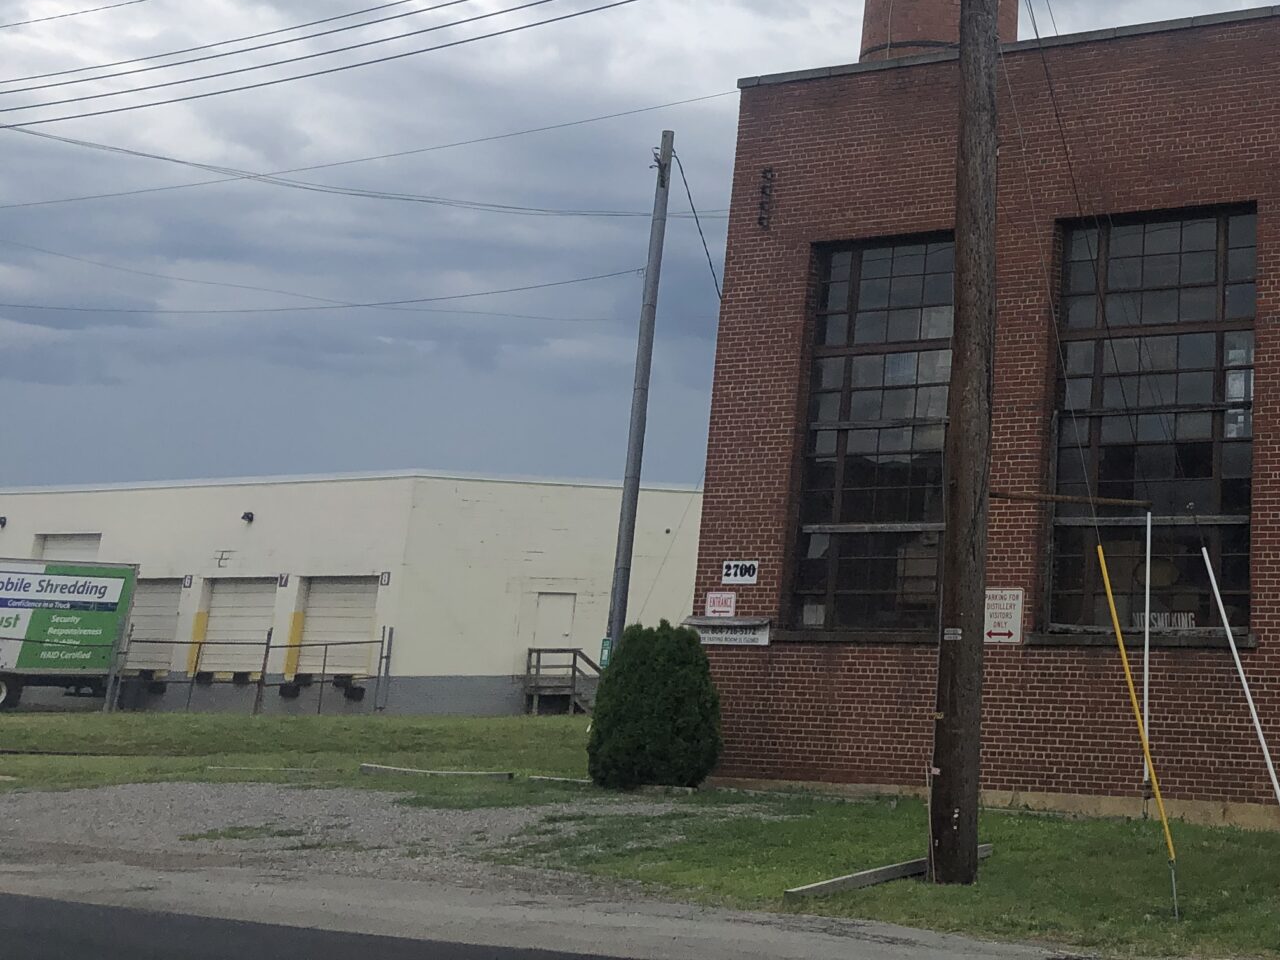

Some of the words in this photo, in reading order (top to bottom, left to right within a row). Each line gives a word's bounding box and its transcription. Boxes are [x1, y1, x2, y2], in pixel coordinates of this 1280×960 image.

[724, 564, 756, 577] 2700
[35, 580, 108, 599] Shredding
[985, 593, 1007, 601] PARKING
[1008, 593, 1019, 601] FOR
[986, 602, 1016, 610] DISTILLERY
[989, 611, 1012, 619] VISITORS
[50, 615, 81, 624] Security
[1150, 612, 1195, 629] SMOKING
[60, 651, 92, 659] Certified
